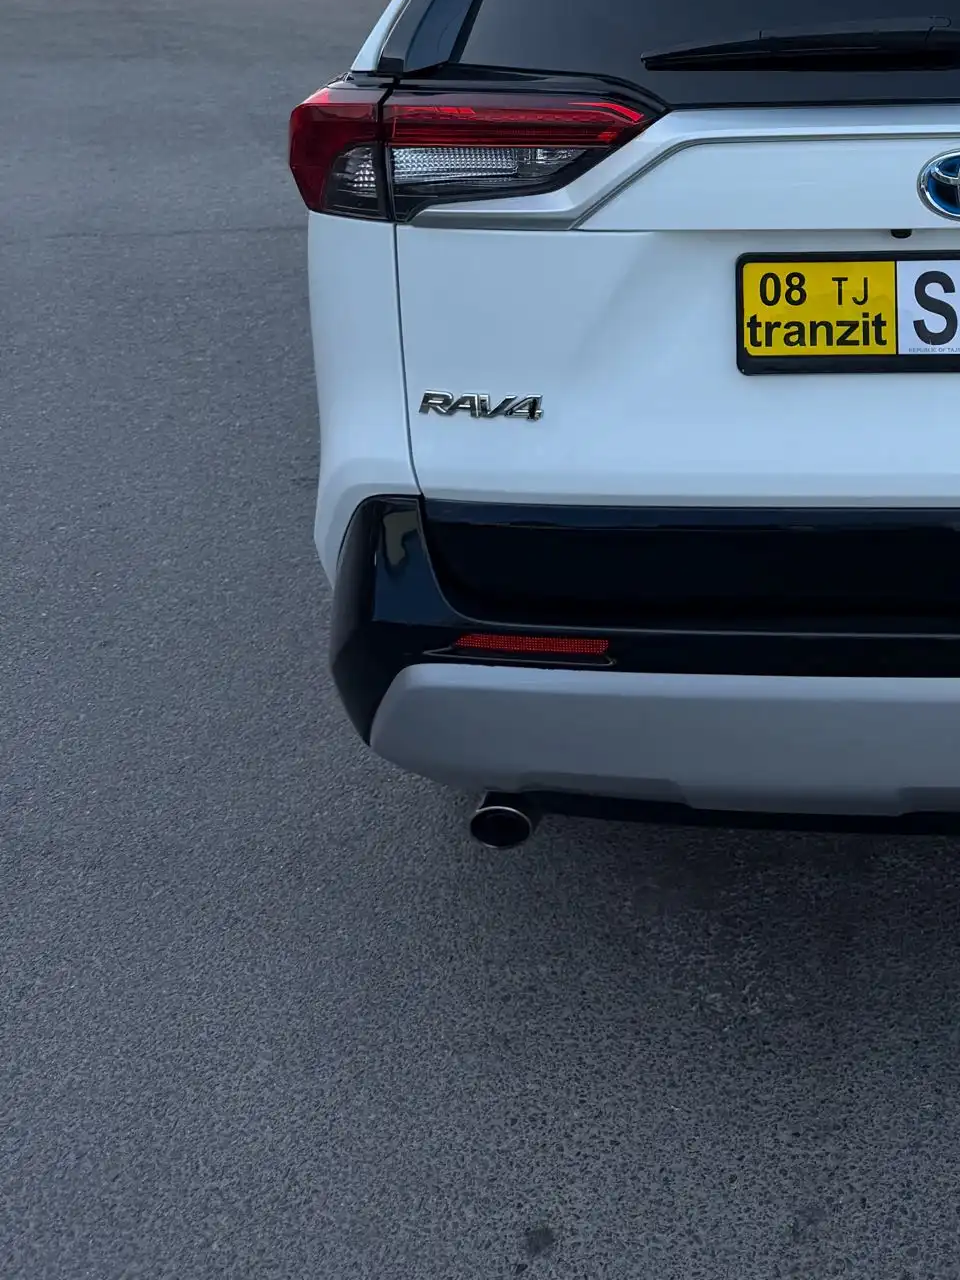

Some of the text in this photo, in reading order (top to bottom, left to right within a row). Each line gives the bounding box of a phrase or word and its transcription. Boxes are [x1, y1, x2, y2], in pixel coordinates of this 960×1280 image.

[759, 272, 869, 306] 08 TJ
[746, 312, 888, 348] tranzit
[418, 389, 543, 421] RAV4
